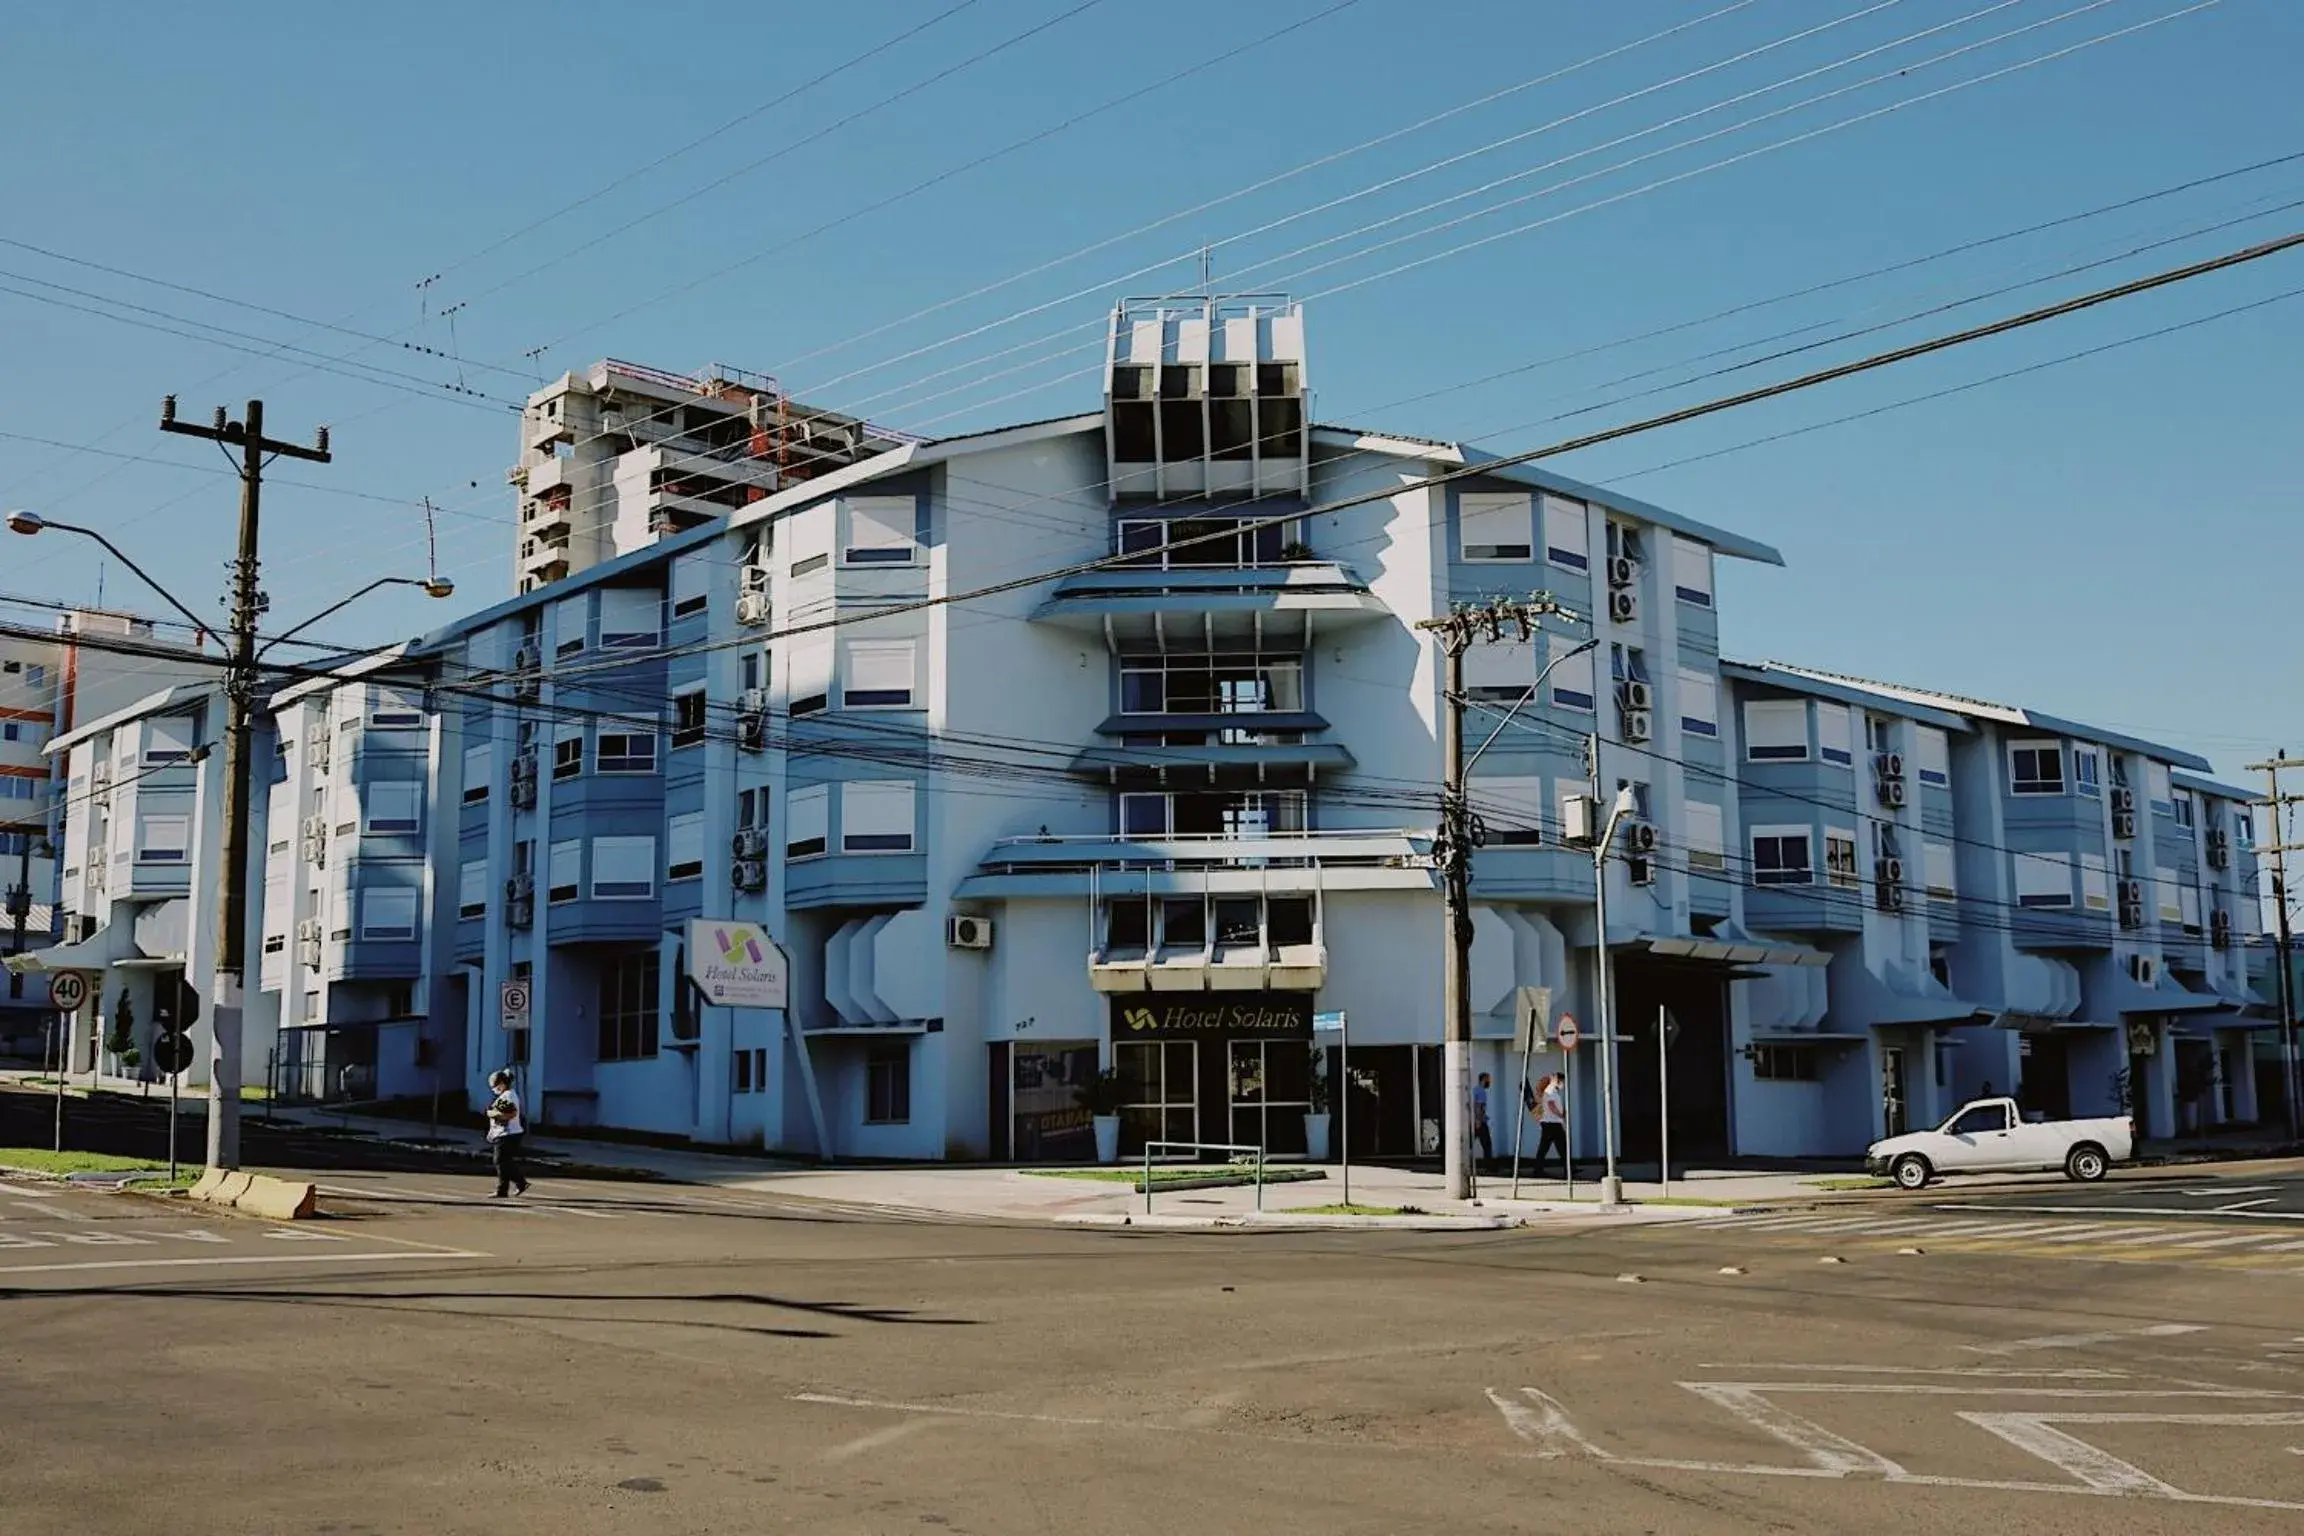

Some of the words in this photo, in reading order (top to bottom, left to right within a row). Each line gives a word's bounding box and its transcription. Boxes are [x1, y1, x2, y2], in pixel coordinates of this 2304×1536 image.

[705, 964, 737, 981] Hotel
[738, 966, 776, 983] Solaris
[55, 979, 80, 998] 40
[510, 993, 520, 1006] E
[1163, 1005, 1224, 1029] Hotel
[1228, 1005, 1300, 1029] Solaris
